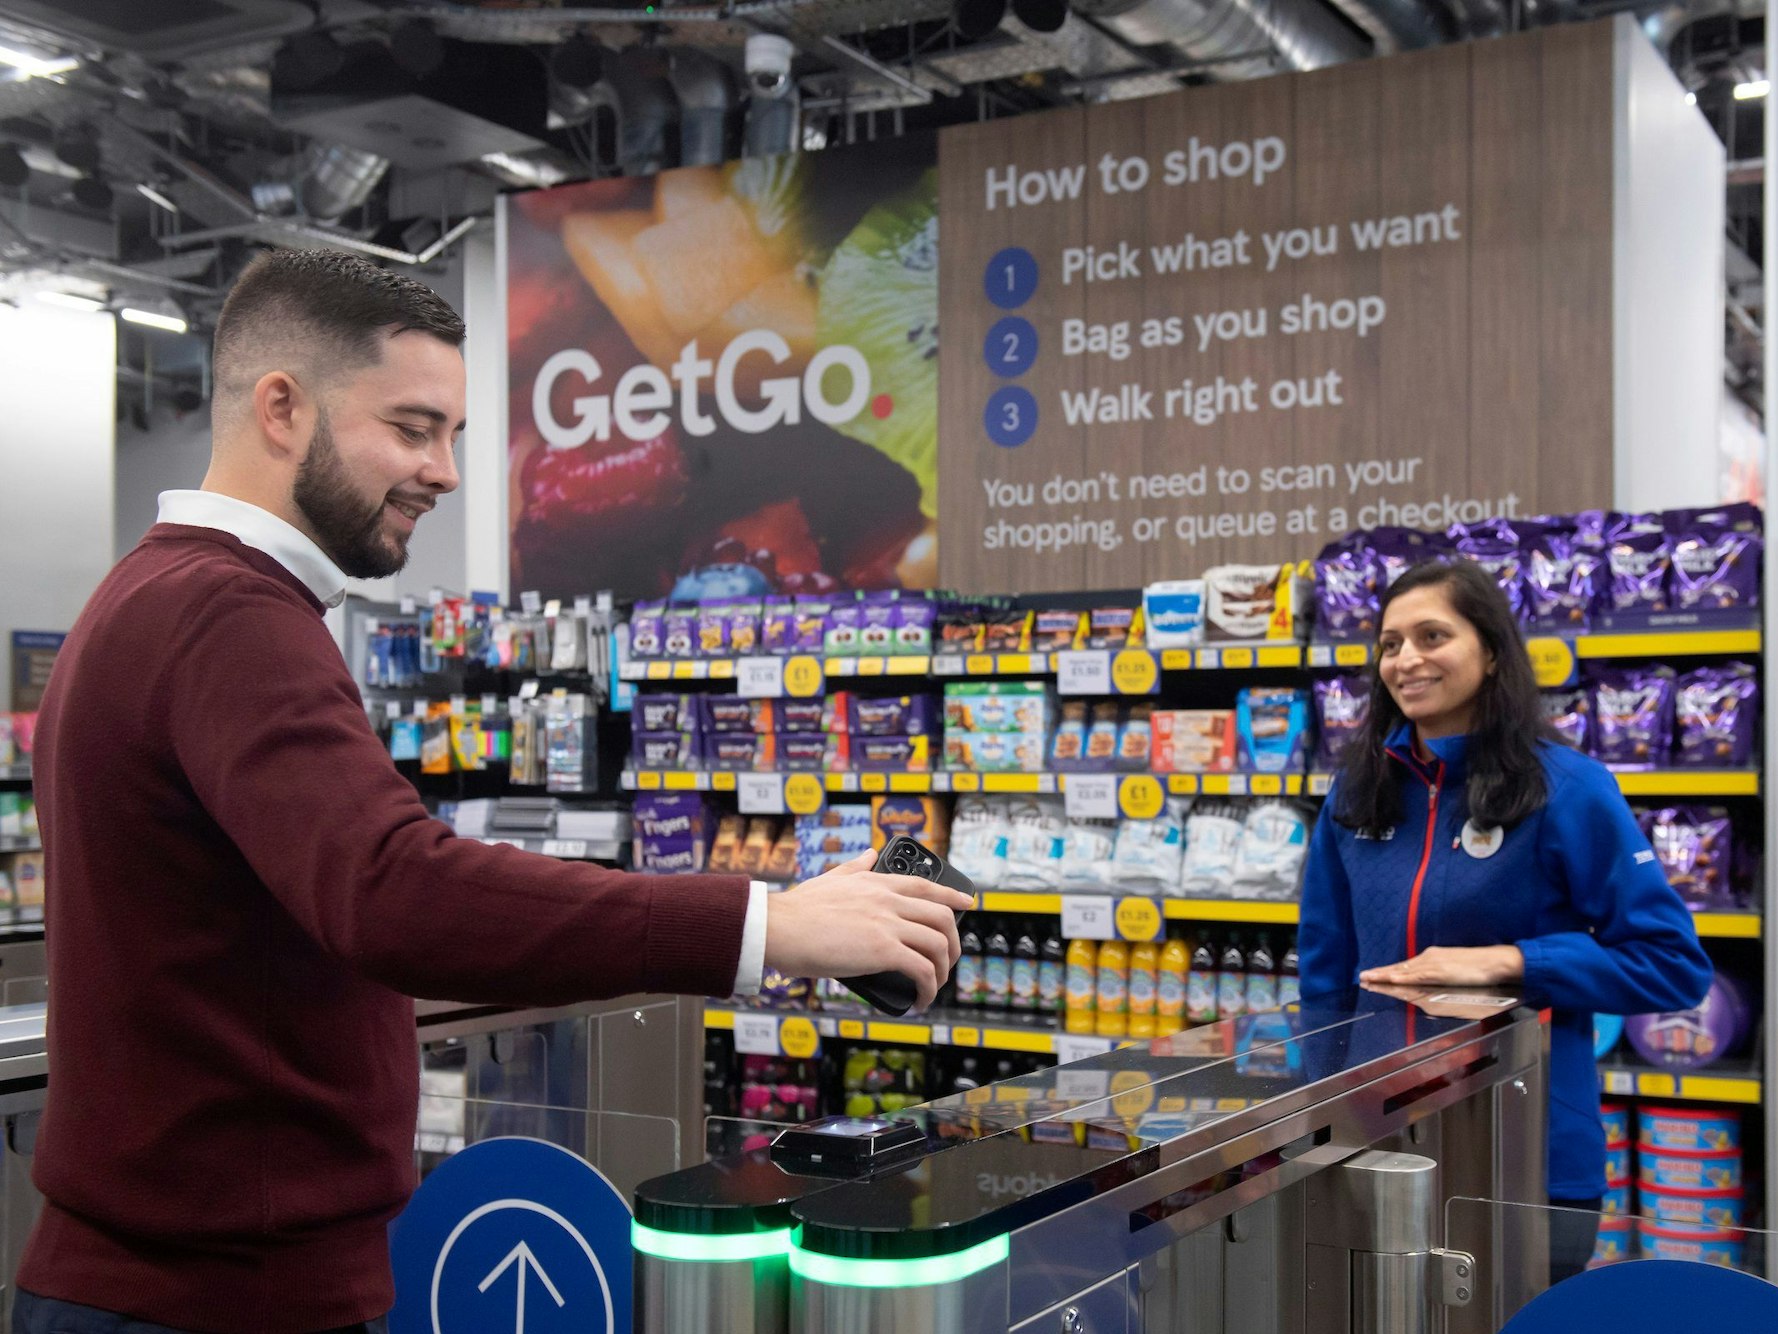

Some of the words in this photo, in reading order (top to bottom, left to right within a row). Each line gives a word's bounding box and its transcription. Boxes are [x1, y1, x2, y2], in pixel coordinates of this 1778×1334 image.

[985, 164, 1085, 211] How
[1097, 152, 1150, 194] to
[1163, 136, 1287, 187] shop
[1004, 264, 1015, 292] 1
[1062, 241, 1141, 285] Pick
[1150, 229, 1252, 274] what
[1261, 225, 1338, 272] you
[1350, 203, 1461, 251] want
[1002, 333, 1019, 362] 2
[1062, 317, 1131, 361] Bag
[1139, 316, 1184, 348] as
[1193, 307, 1268, 353] you
[1280, 293, 1387, 337] shop
[1002, 402, 1020, 431] 3
[1060, 380, 1153, 426] Walk
[1164, 374, 1259, 426] right
[1269, 368, 1343, 410] out
[983, 479, 1035, 508] You
[1041, 472, 1120, 505] don't
[1128, 465, 1207, 499] need
[1216, 466, 1251, 494] to
[1259, 463, 1336, 492] scan
[1344, 457, 1422, 494] your
[984, 515, 1123, 553] shopping,
[1132, 517, 1168, 542] or
[1175, 510, 1277, 546] queue
[1285, 504, 1319, 534] at
[1328, 507, 1349, 532] a
[1129, 784, 1149, 800] £1
